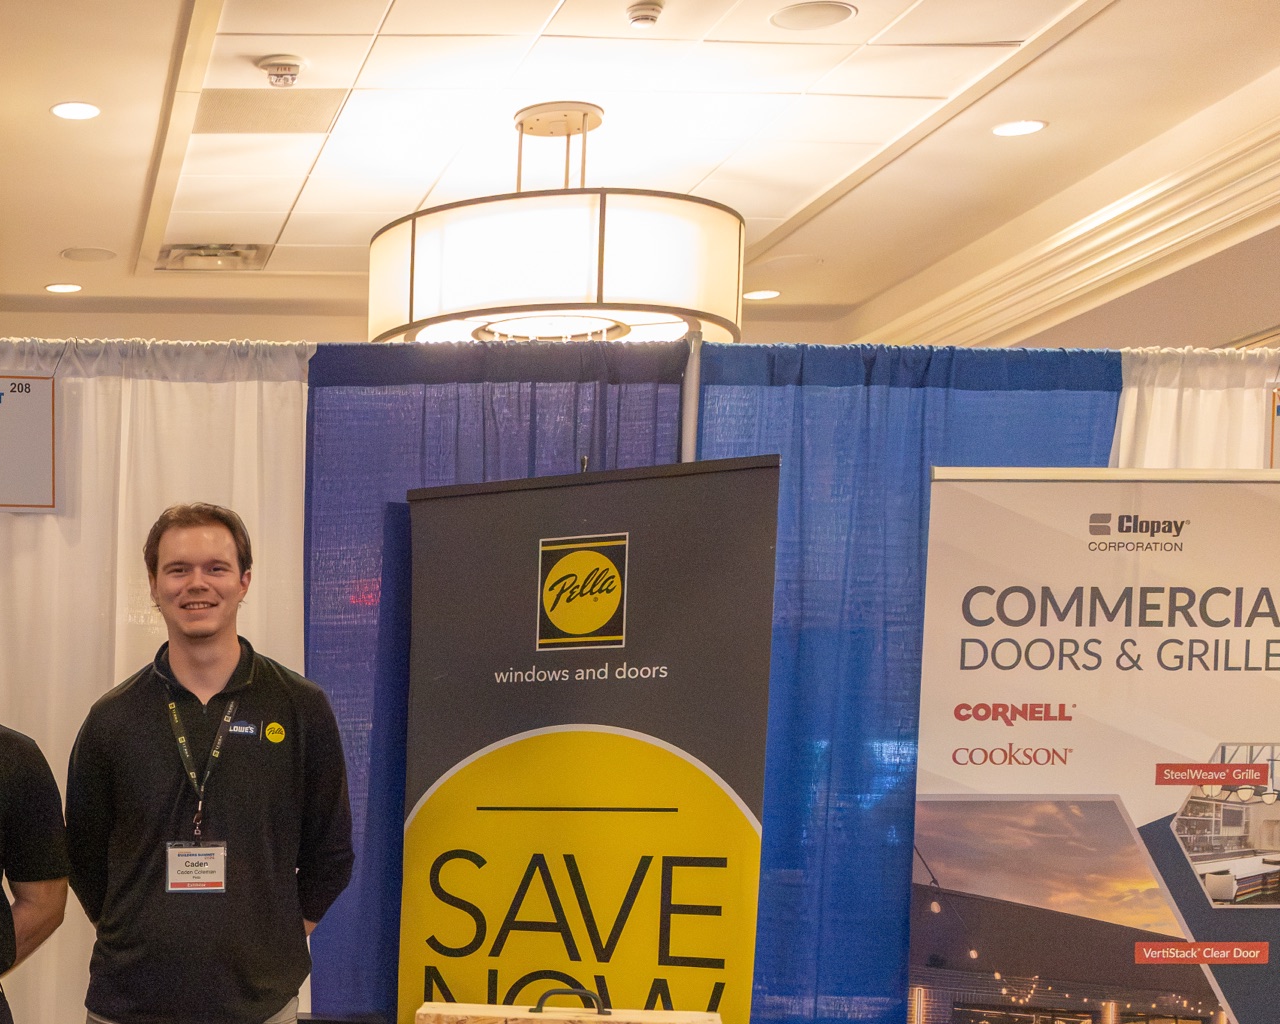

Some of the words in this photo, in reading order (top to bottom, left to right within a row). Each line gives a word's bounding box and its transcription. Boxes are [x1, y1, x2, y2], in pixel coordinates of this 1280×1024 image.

[9, 382, 31, 394] 208
[1088, 541, 1184, 552] CORPORATION
[548, 567, 617, 612] Pella
[961, 586, 1280, 629] COMMERCIA
[960, 638, 1103, 671] DOORS
[1115, 638, 1144, 671] &
[1156, 638, 1280, 671] GRILLE
[494, 664, 570, 684] windows
[574, 662, 609, 682] and
[614, 661, 668, 680] doors
[953, 703, 1073, 726] CORNELL
[229, 725, 255, 734] LOWE'S
[1232, 768, 1261, 780] Grille
[424, 848, 729, 971] SAVE
[1203, 947, 1230, 960] Clear
[1233, 947, 1260, 960] Door
